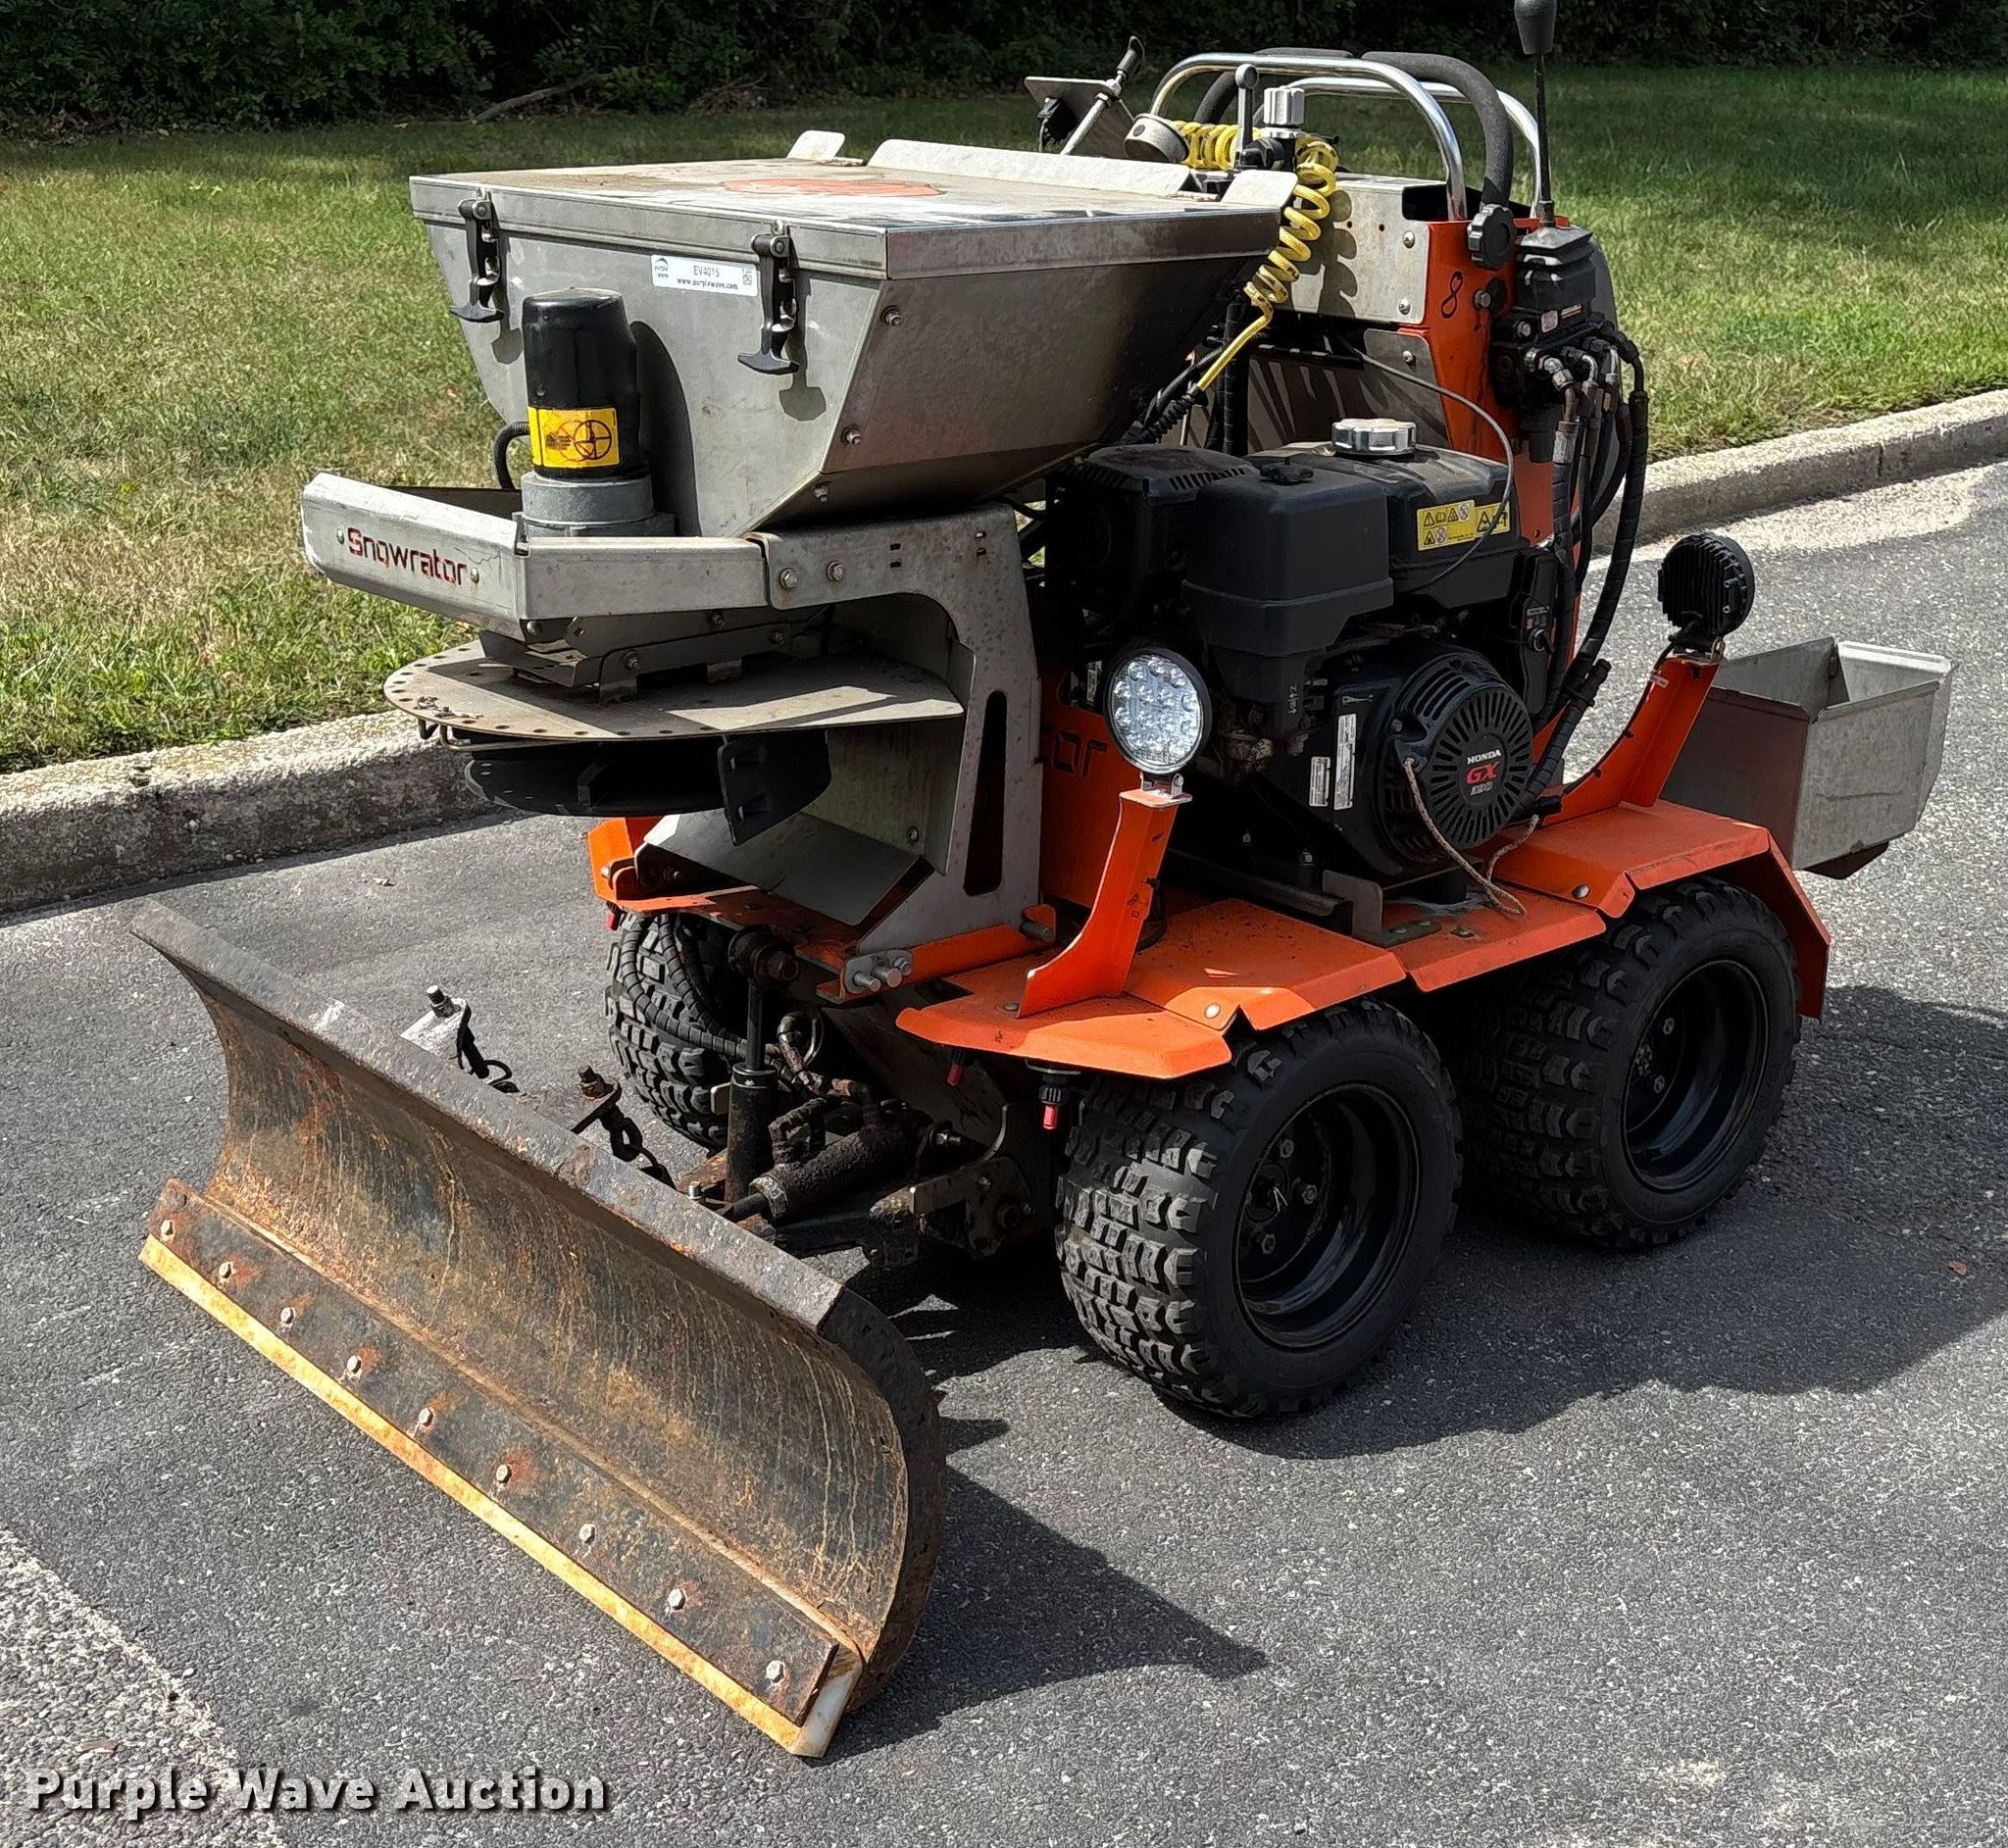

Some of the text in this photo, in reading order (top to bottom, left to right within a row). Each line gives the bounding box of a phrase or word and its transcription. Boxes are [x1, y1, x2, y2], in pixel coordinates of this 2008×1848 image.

[693, 265, 720, 277] EV4015
[1440, 271, 1464, 319] 8
[347, 526, 467, 585] Snowrator
[1042, 724, 1108, 781] or
[1467, 749, 1502, 765] HONDA
[1466, 761, 1500, 784] GX
